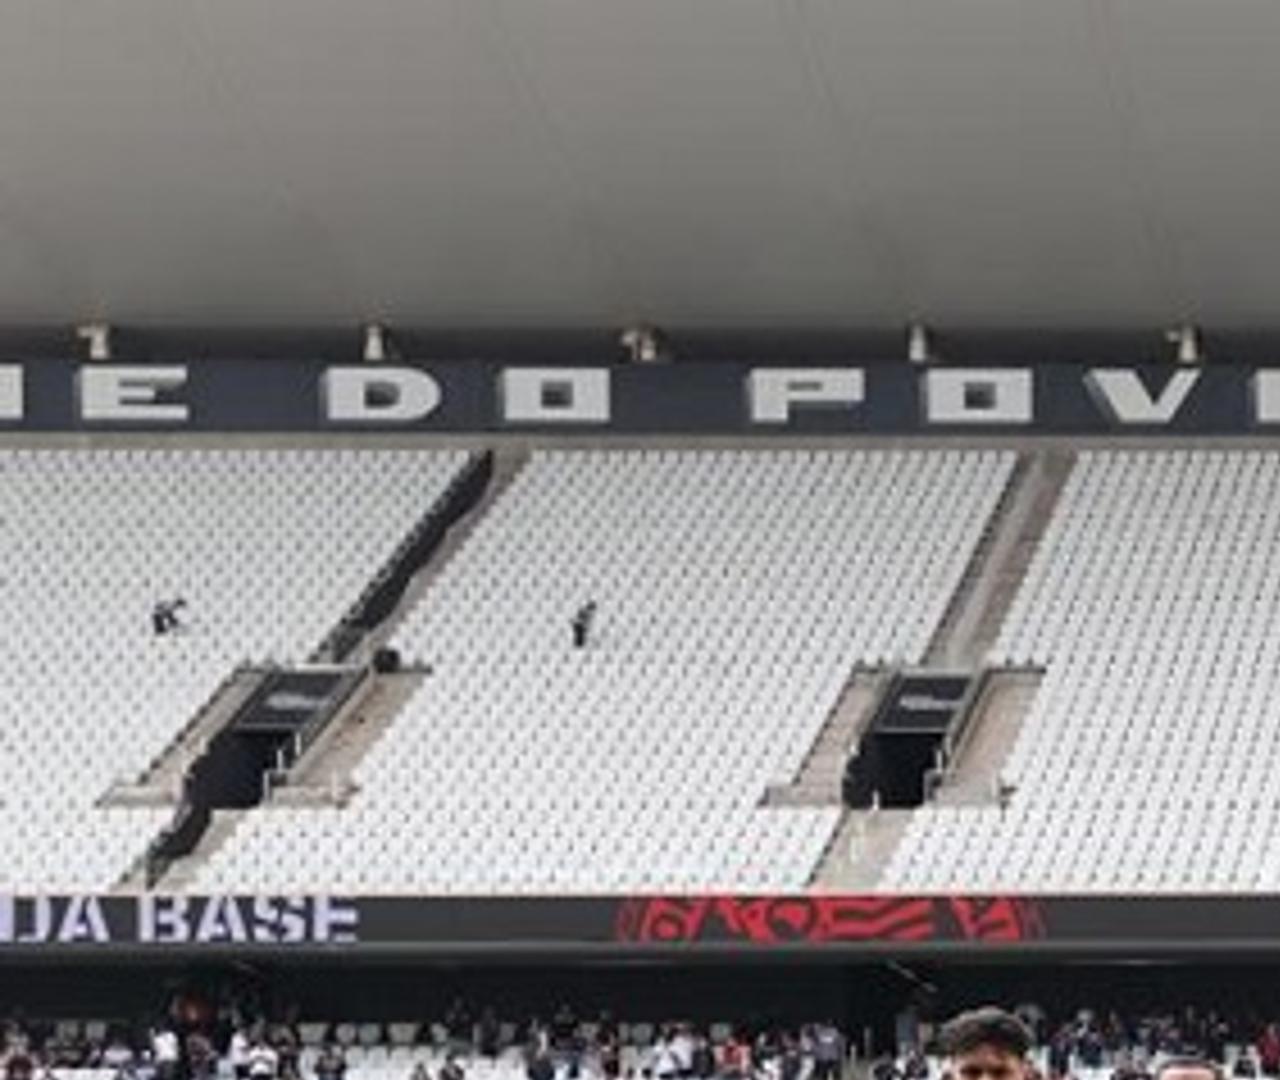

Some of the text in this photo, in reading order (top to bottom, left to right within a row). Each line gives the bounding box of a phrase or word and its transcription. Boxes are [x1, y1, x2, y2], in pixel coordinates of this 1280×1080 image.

[0, 365, 188, 419] E
[325, 365, 610, 421] DO
[0, 893, 359, 943] DA BASE
